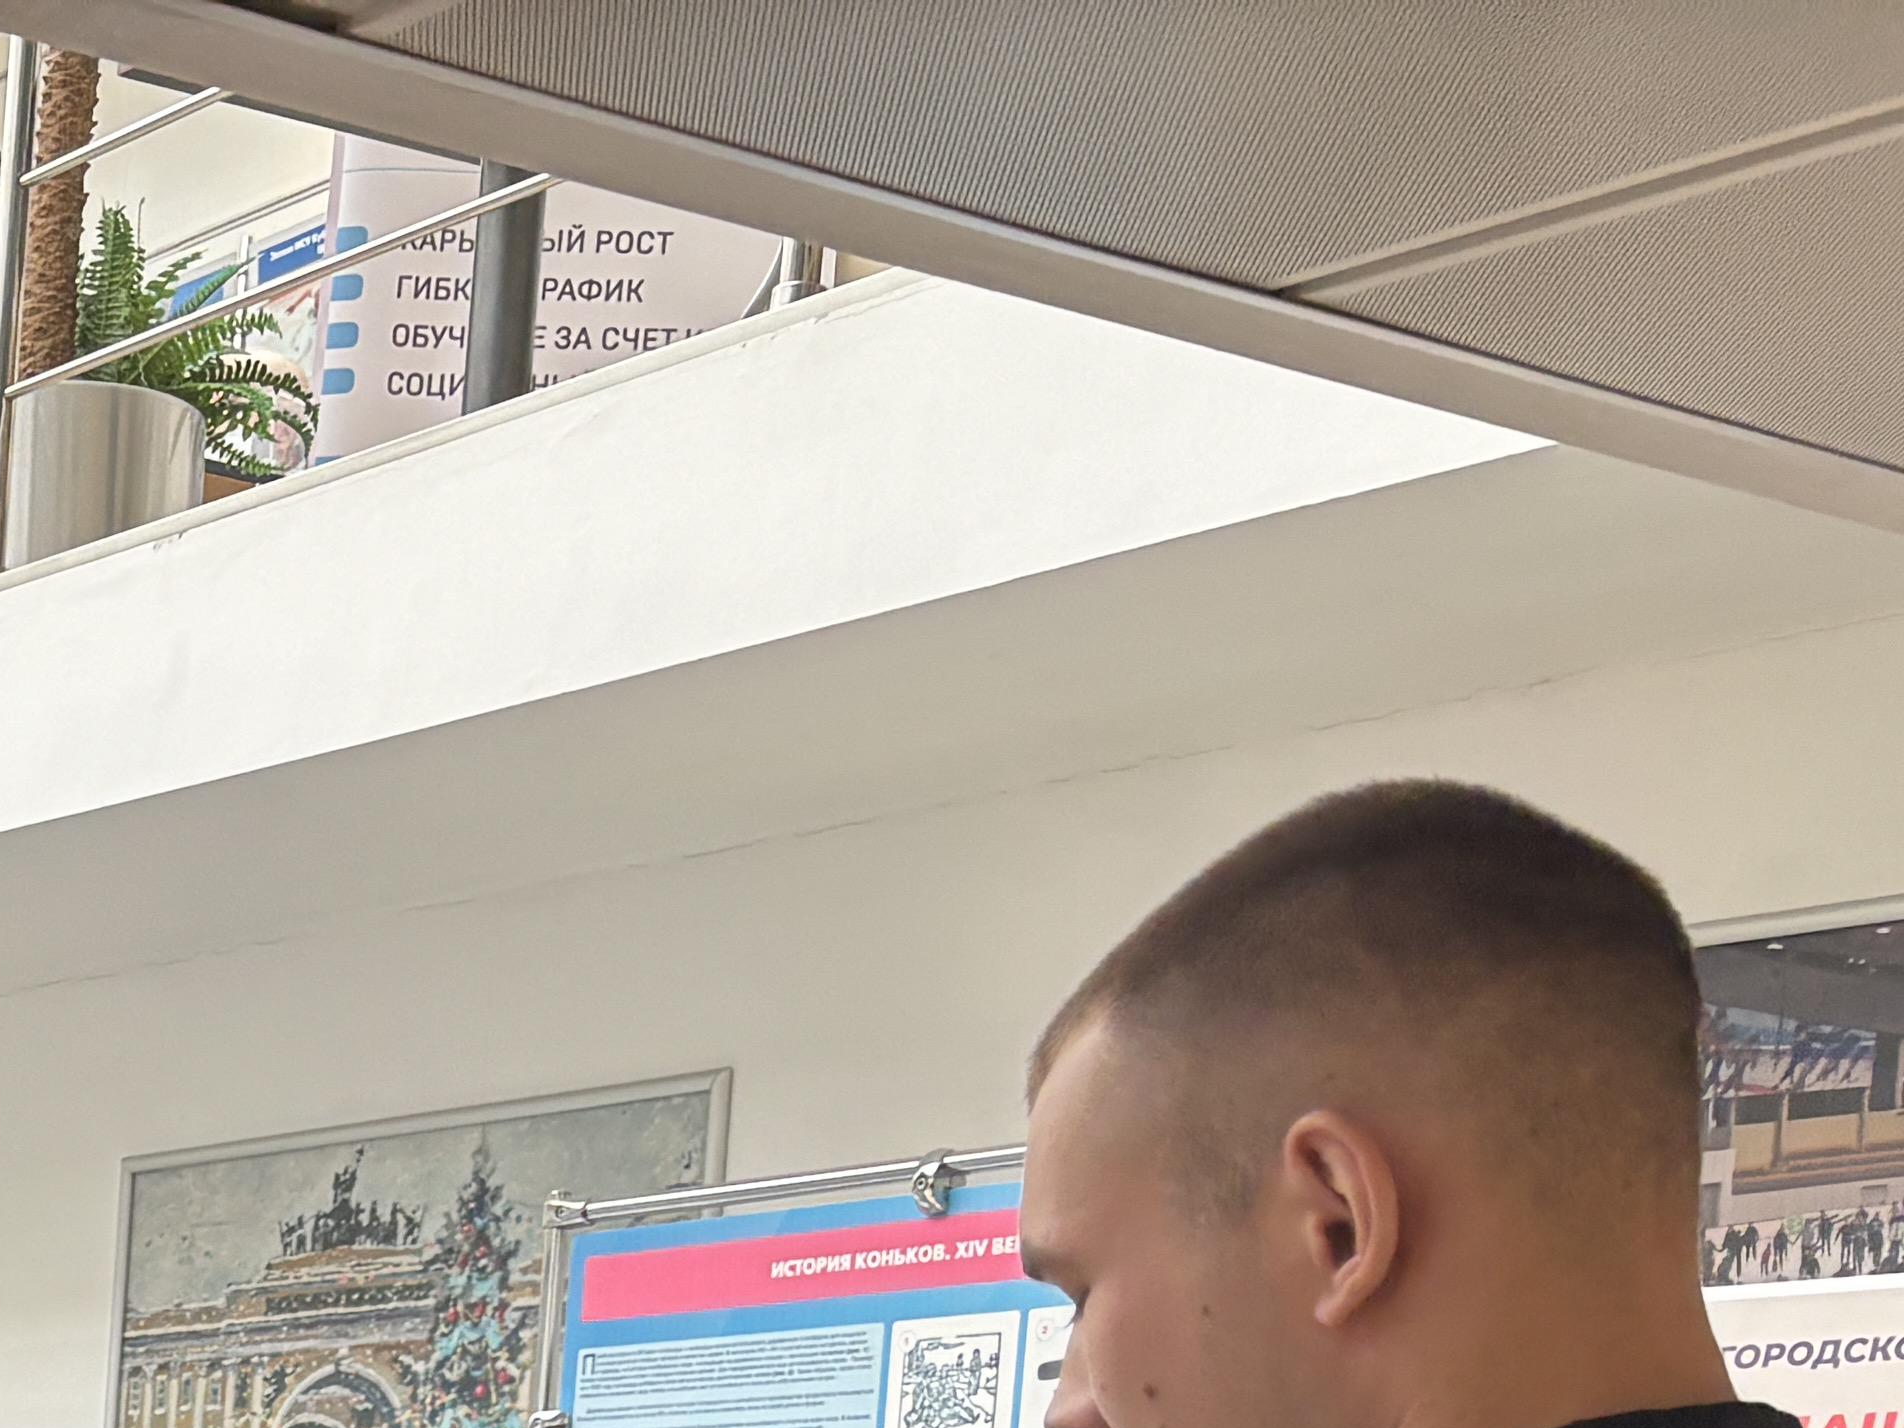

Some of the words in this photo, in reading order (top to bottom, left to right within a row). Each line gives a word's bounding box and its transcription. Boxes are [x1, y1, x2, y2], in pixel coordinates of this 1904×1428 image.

[596, 230, 673, 255] РОСТ
[397, 276, 470, 300] ГИБК
[542, 278, 644, 302] РАФИК
[554, 325, 591, 349] ЗА
[602, 327, 677, 352] СЧЕТ
[771, 1254, 852, 1279] ИСТОРИЯ
[855, 1245, 951, 1270] КОНЬКОВ.
[954, 1239, 988, 1259] XIV
